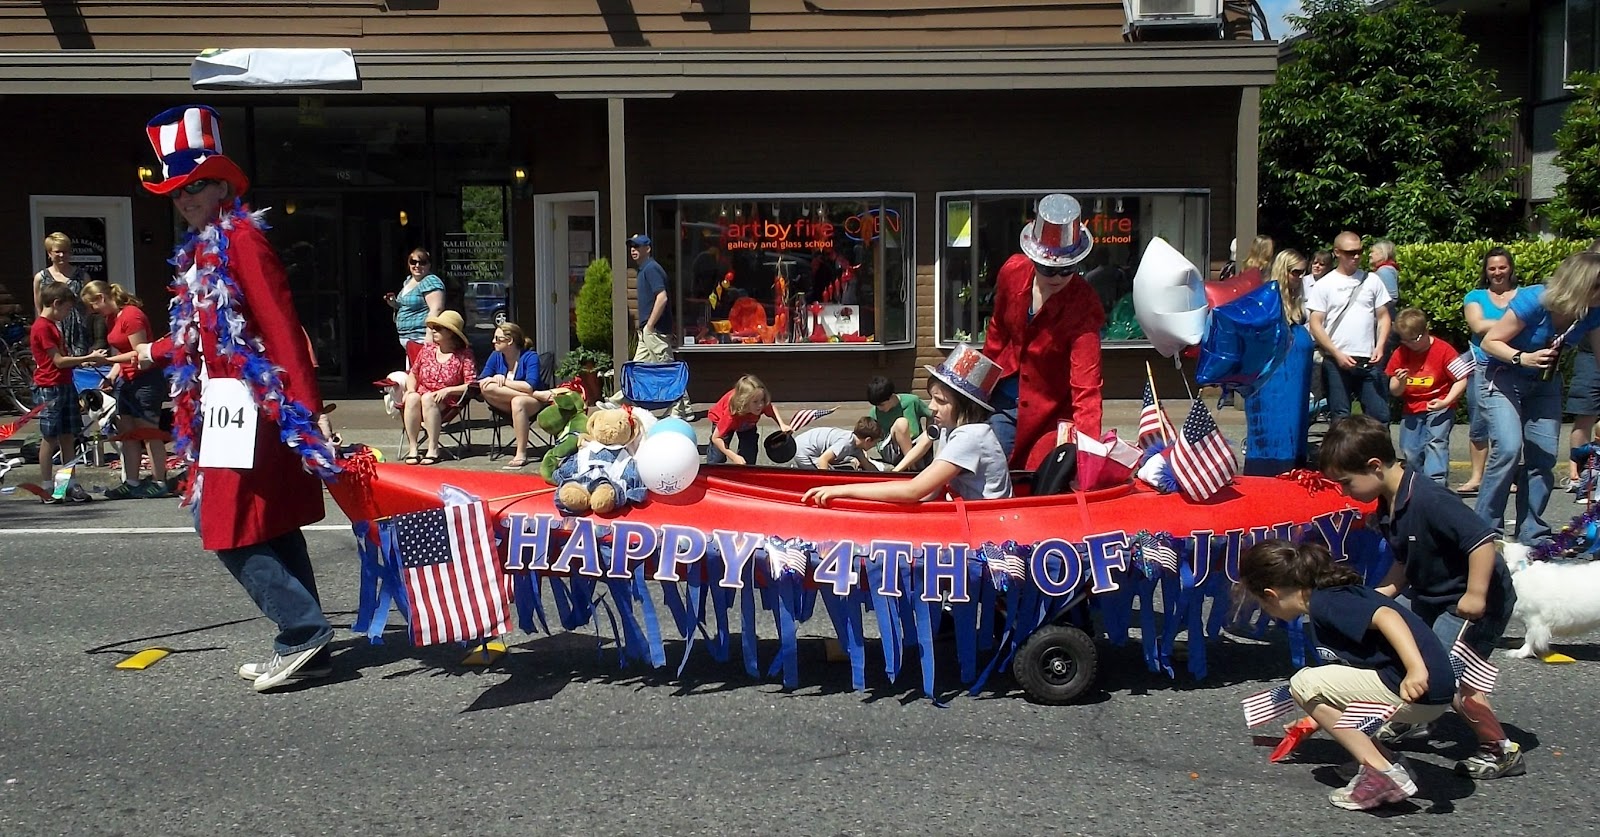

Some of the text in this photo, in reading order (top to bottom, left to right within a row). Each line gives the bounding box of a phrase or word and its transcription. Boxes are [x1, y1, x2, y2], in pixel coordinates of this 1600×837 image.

[728, 219, 835, 241] art by fire
[844, 215, 900, 234] OEN
[1094, 214, 1132, 232] fire
[727, 239, 834, 250] gallery and glass school
[1102, 235, 1131, 244] school
[208, 405, 245, 429] 104
[503, 507, 1360, 602] HAPPY 4TH OF JUY
